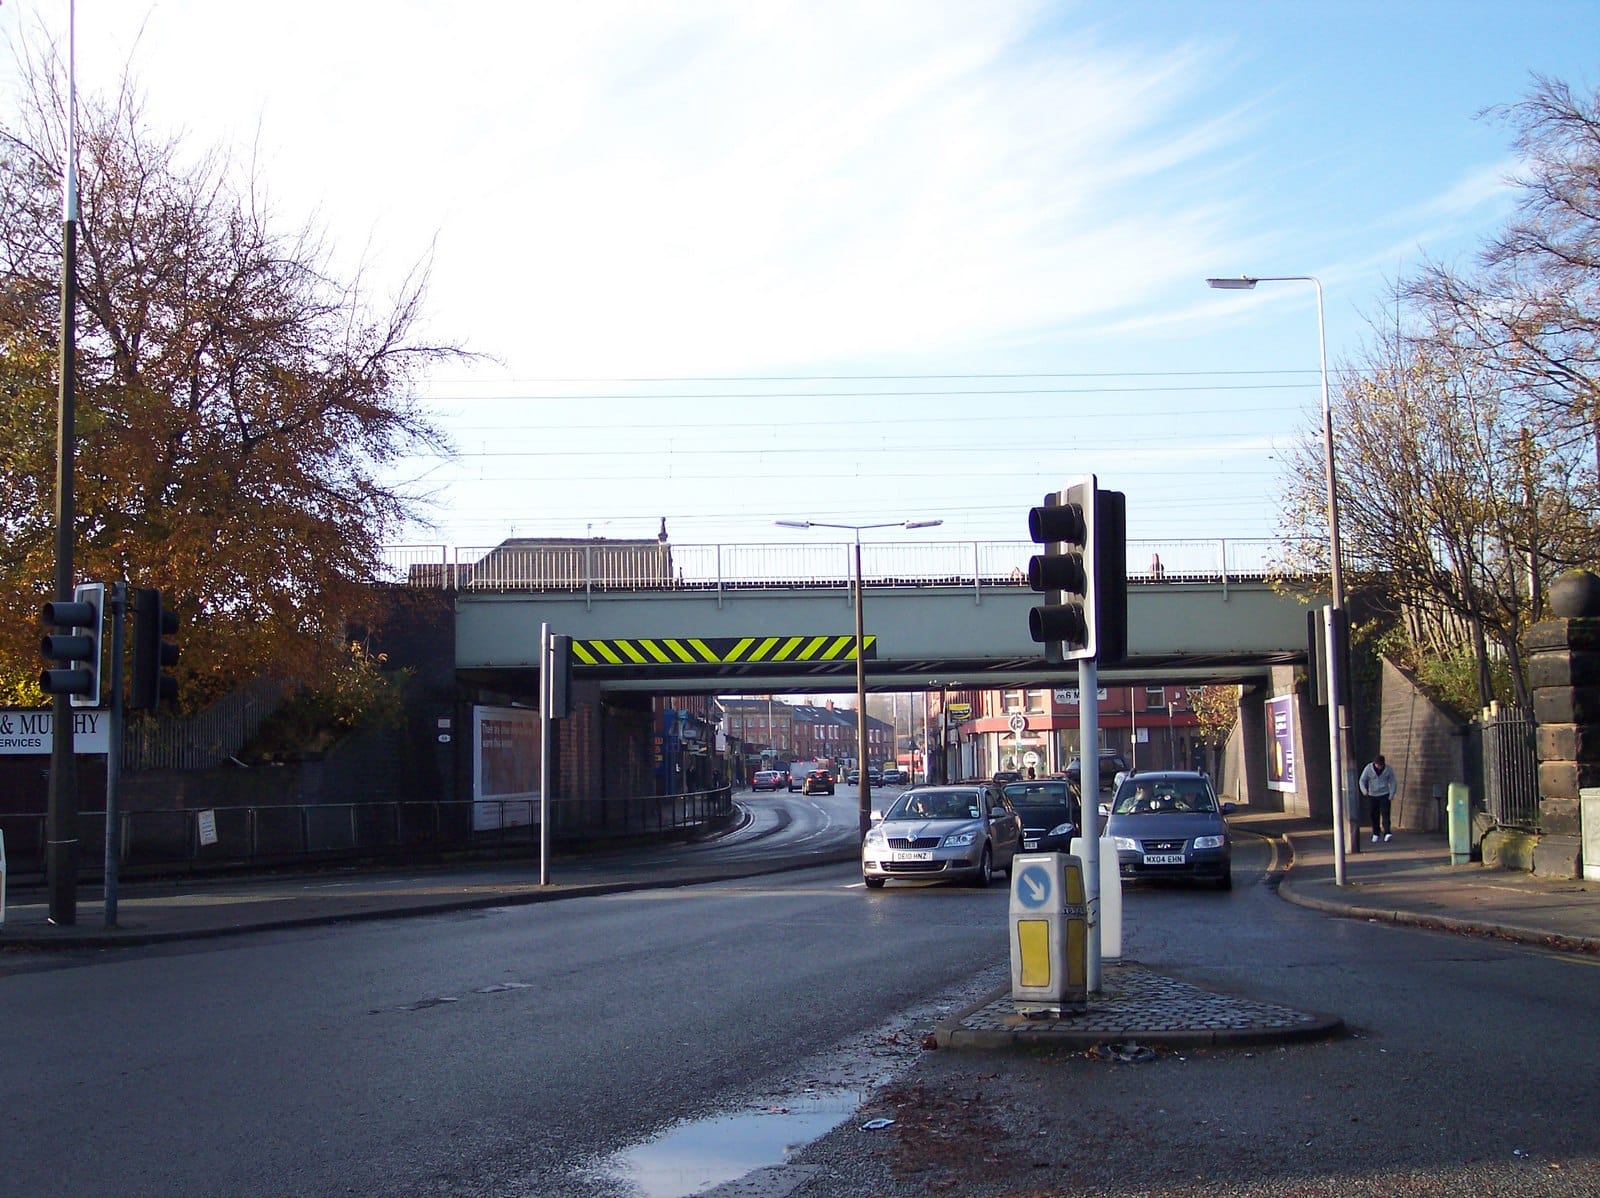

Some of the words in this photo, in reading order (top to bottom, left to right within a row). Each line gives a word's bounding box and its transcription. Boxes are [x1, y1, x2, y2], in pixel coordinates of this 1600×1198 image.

[0, 714, 14, 735] &
[19, 713, 99, 735] MUHY
[913, 852, 927, 860] HNZ
[1146, 855, 1166, 863] MX04
[1167, 855, 1182, 863] EHN
